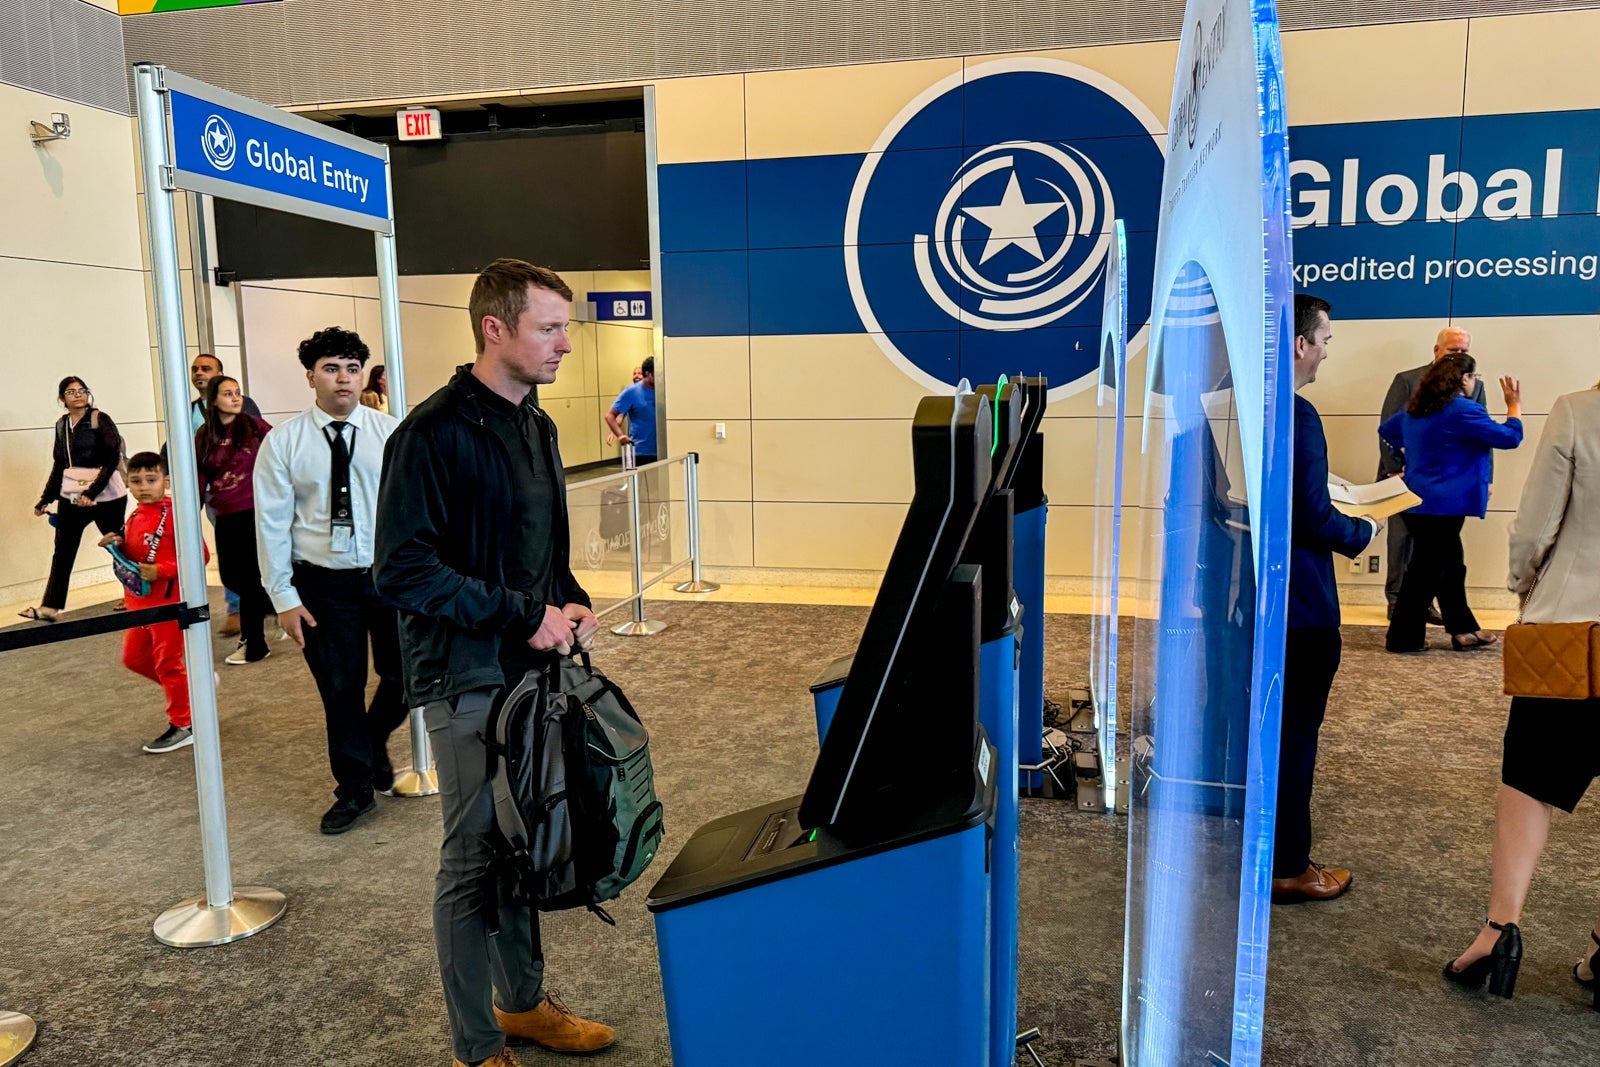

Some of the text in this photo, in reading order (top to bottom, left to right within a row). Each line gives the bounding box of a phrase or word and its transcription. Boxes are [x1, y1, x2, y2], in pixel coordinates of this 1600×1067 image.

[405, 113, 431, 136] EXIT
[246, 139, 369, 203] Global Entry
[1289, 148, 1563, 230] Global
[1293, 250, 1598, 288] xpedited processing
